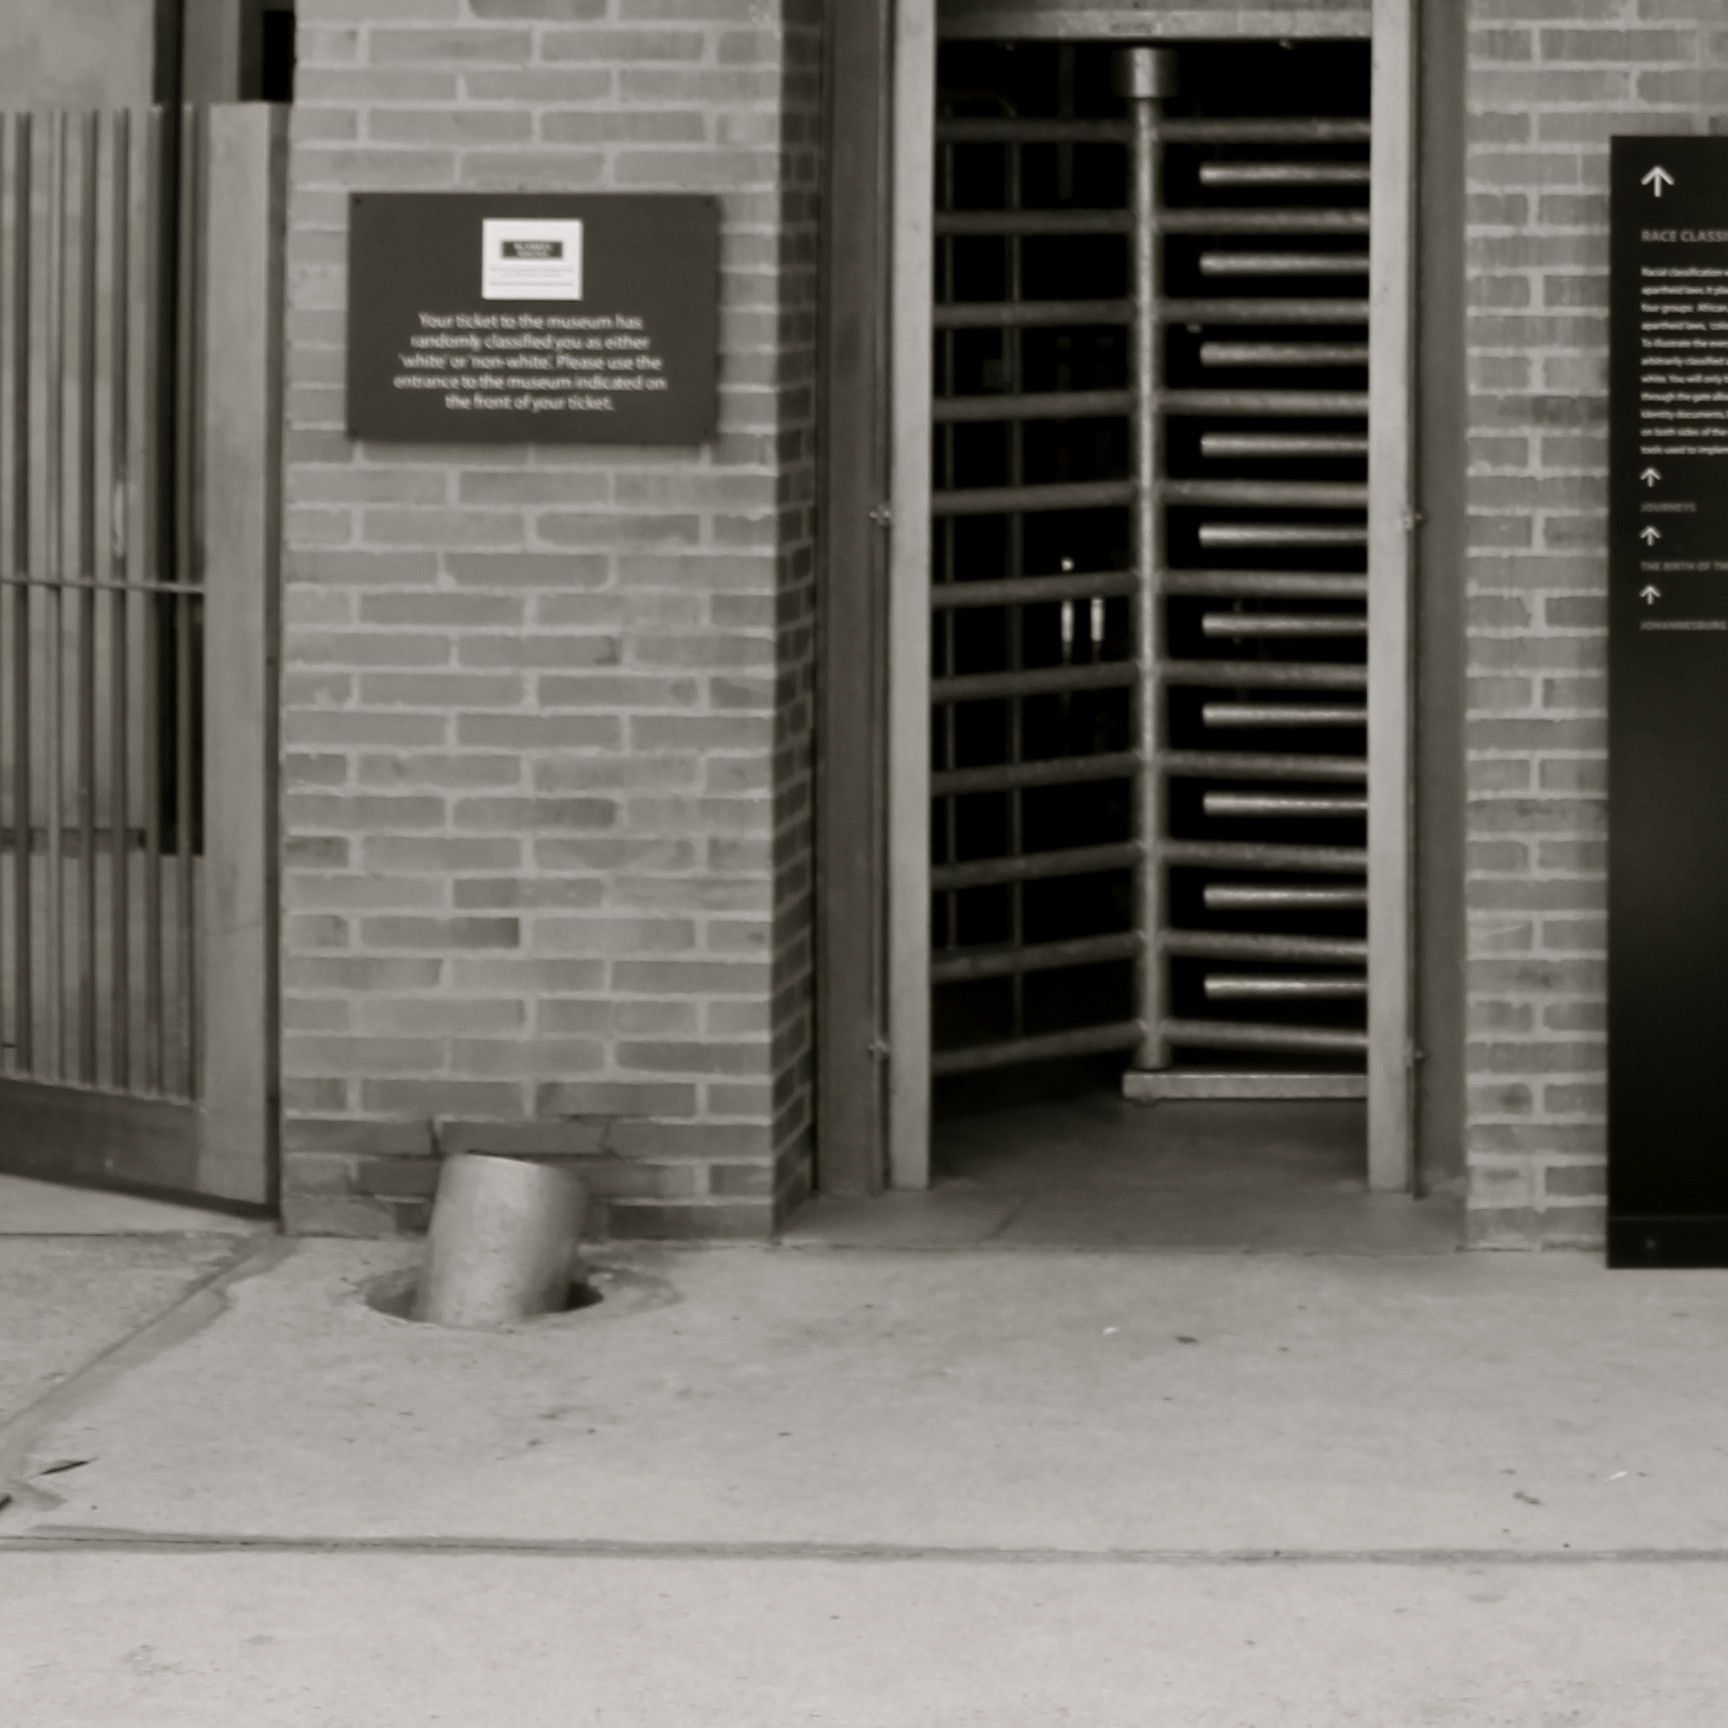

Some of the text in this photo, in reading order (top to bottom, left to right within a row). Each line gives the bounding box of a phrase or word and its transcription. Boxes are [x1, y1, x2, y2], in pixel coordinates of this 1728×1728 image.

[1641, 230, 1677, 243] RACE
[418, 313, 644, 330] Your ticket to the museum has
[410, 334, 650, 353] randomly classified you as either
[449, 357, 468, 369] or
[556, 356, 604, 370] Please
[607, 358, 633, 370] use
[635, 356, 663, 370] the
[393, 375, 668, 391] entrance to the museum indicated on
[445, 394, 471, 410] the
[474, 393, 513, 410] front
[514, 394, 530, 410] of
[531, 398, 566, 413] your
